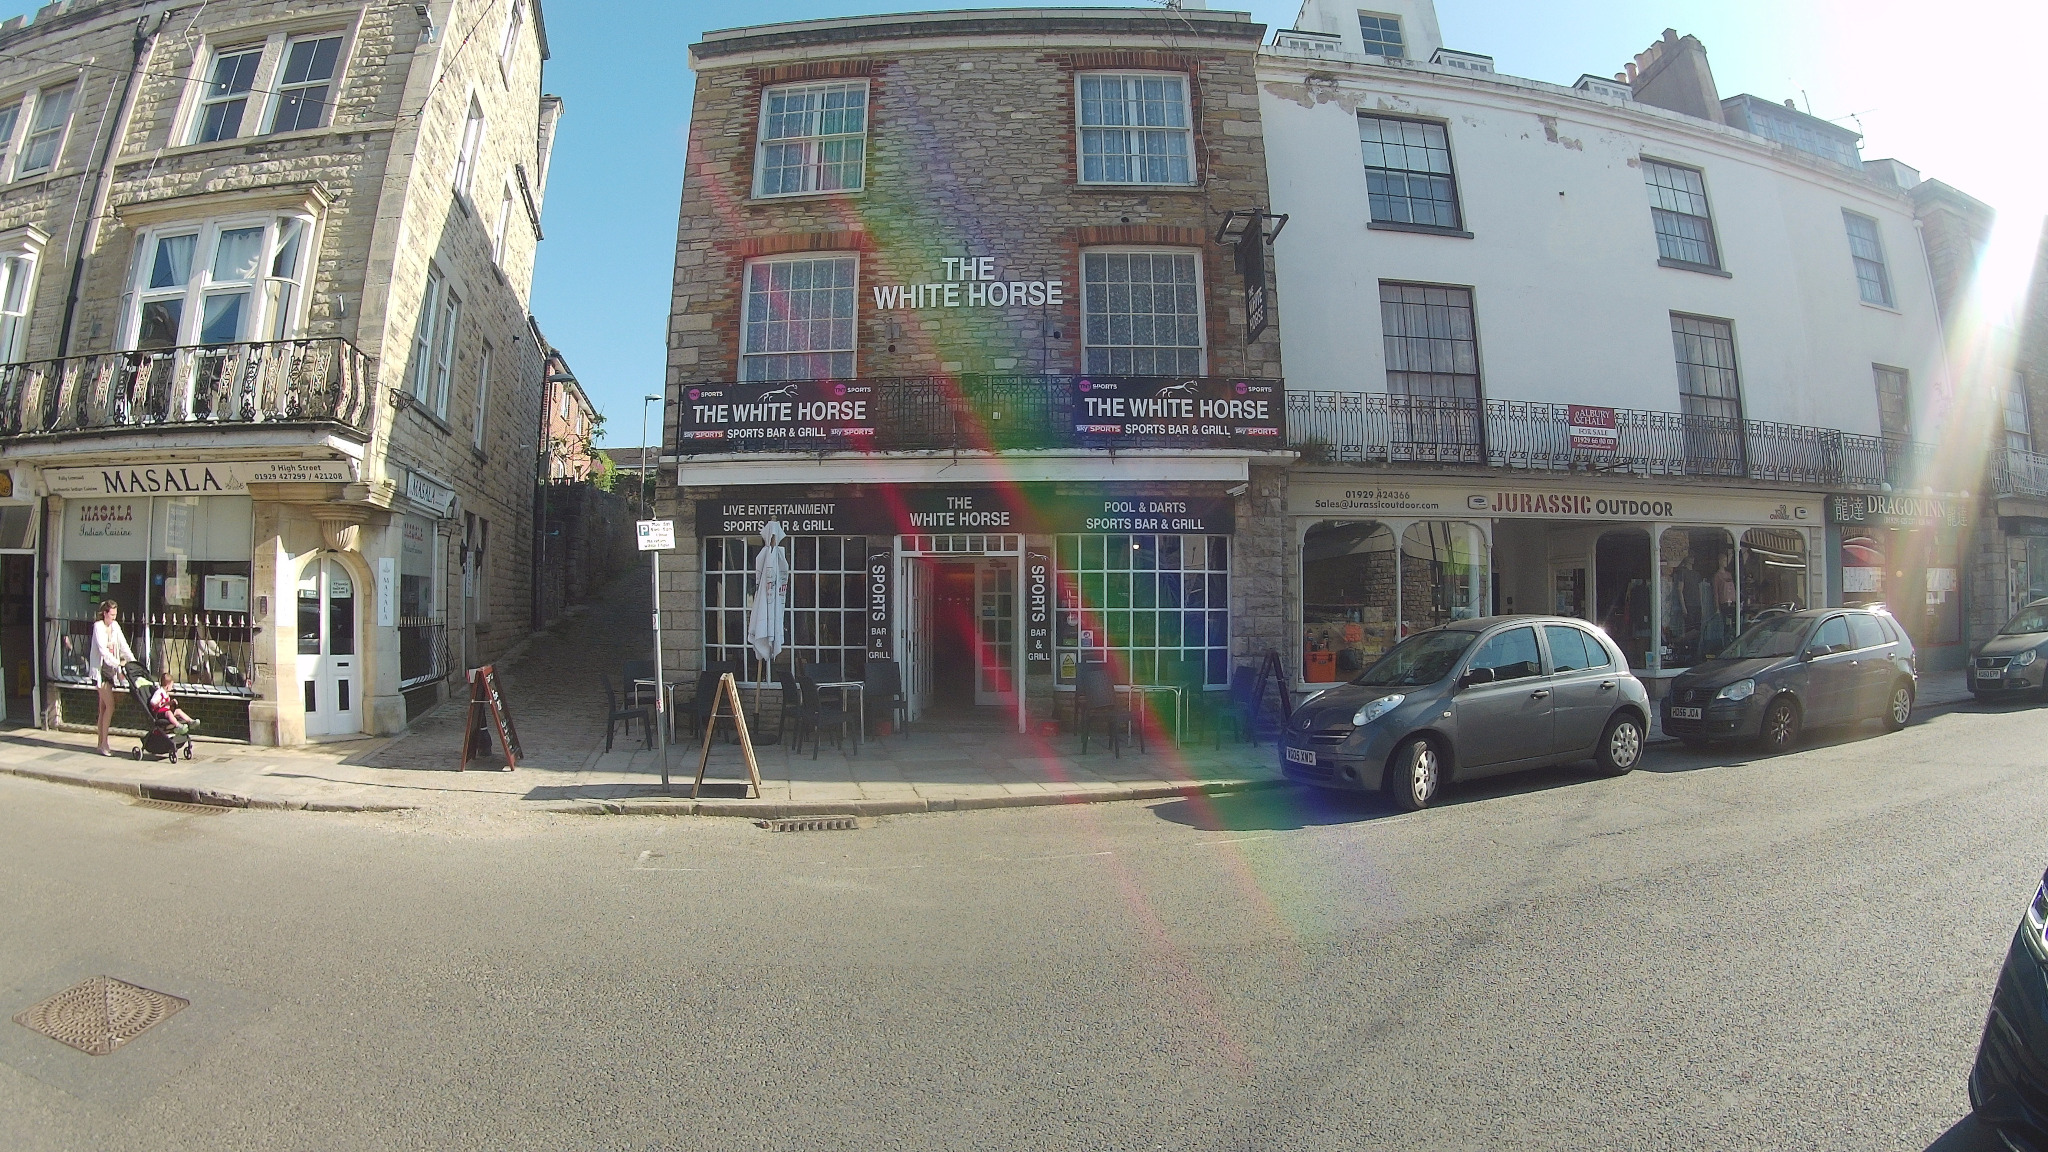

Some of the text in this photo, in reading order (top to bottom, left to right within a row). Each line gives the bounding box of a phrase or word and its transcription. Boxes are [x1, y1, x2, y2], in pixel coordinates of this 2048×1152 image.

[942, 256, 995, 281] THE
[873, 280, 1064, 310] WHITE HORSE
[692, 400, 867, 424] THE WHITE HORSE
[1084, 397, 1269, 419] THE WHITE HORSE
[1579, 409, 1610, 419] ALBURY
[1574, 411, 1607, 426] & HALL
[683, 431, 694, 439] sky
[727, 427, 826, 439] SPORTS BAR & GRILL
[830, 428, 874, 436] sky SPORTS
[1076, 425, 1121, 433] sky SPORTS
[1125, 424, 1231, 435] SPORTS BAR & GRILL
[1235, 427, 1277, 435] sky SPORTS
[1573, 436, 1591, 444] 01929
[278, 464, 296, 473] High
[101, 466, 223, 494] MASALA
[308, 473, 312, 481] /
[314, 472, 343, 480] 421208
[411, 478, 436, 505] MASALA
[1345, 490, 1410, 500] 01929 424366
[946, 496, 973, 509] THE
[1104, 501, 1187, 513] POOL & DARTS
[1315, 499, 1439, 510] Sales@Jurassicoutdoor.com
[1491, 492, 1673, 517] JURASSIC OUTDOOR
[1834, 495, 1865, 521] 龍達
[1867, 494, 1946, 518] DRAGON INN
[80, 504, 133, 521] MASALA
[723, 503, 836, 516] LIVE ENTERTAINMENT
[1946, 504, 1968, 527] 龍達
[909, 511, 1010, 526] WHITE HORSE
[1086, 518, 1205, 530] SPORTS BAR & GRILL
[79, 522, 132, 537] Indian Cuisine
[723, 520, 765, 532] SPORTS
[792, 520, 800, 531] &
[802, 519, 835, 531] GRILL
[871, 564, 886, 621] SPORTS
[1031, 565, 1046, 622] SPORTS
[871, 627, 887, 636] BAR
[1030, 628, 1047, 637] BAR
[875, 639, 883, 648] &
[1035, 639, 1042, 650] &
[868, 651, 891, 659] GRILL
[1028, 652, 1050, 661] GRILL
